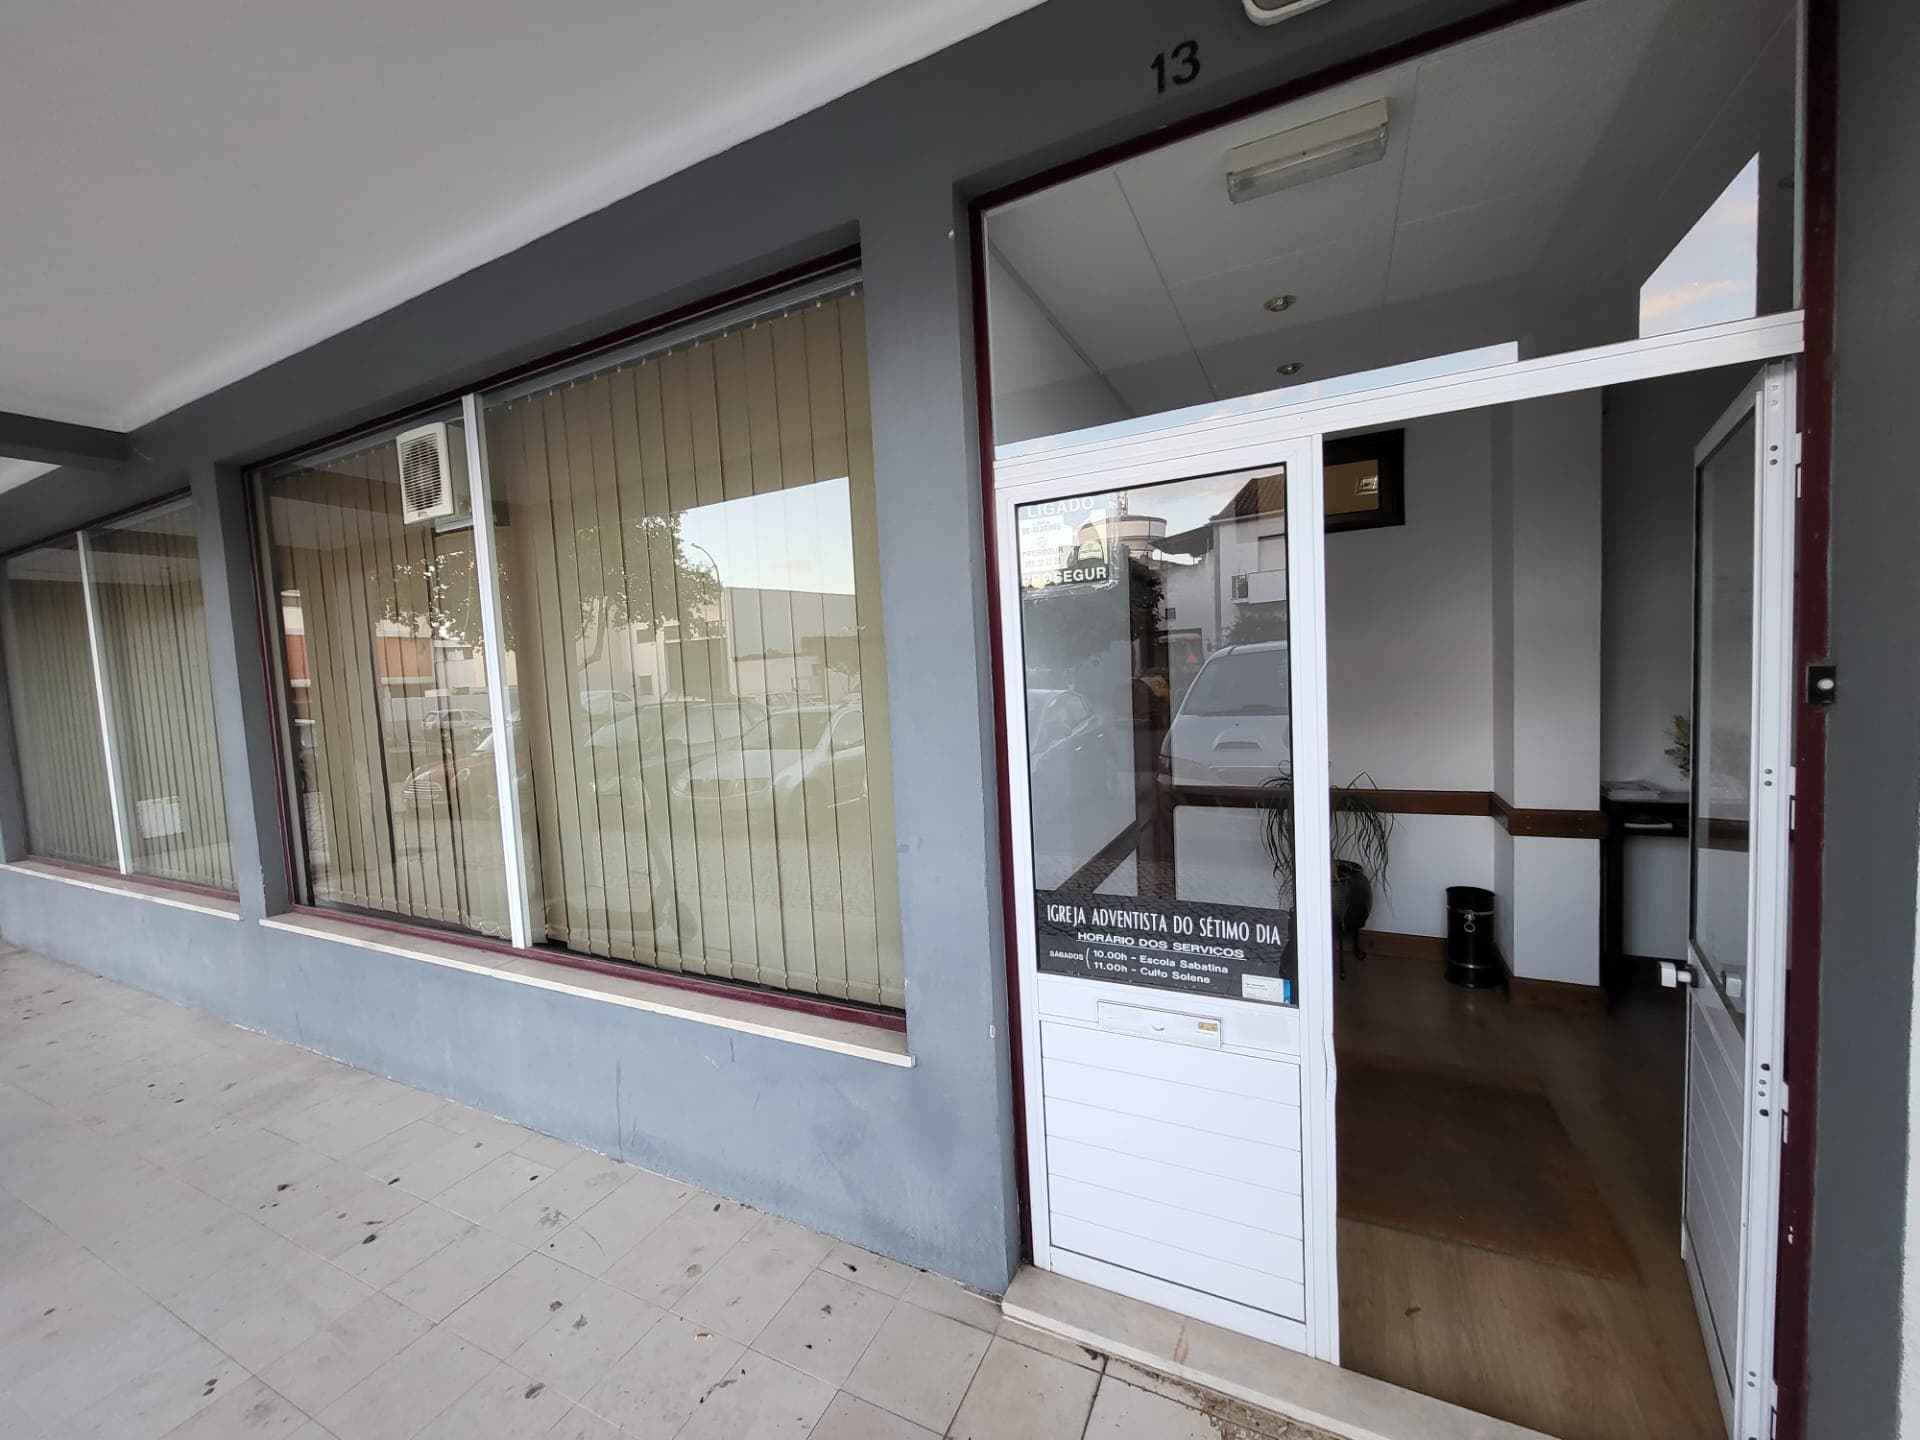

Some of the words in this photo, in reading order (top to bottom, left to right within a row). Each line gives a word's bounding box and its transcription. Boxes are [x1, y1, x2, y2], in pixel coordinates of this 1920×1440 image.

[1150, 40, 1200, 93] 13
[1027, 496, 1094, 518] LIGADO
[1047, 904, 1086, 927] IGREJA
[1091, 908, 1168, 933] ADVENTISTA
[1173, 915, 1193, 935] DO
[1199, 916, 1250, 942] SÉTIMO
[1256, 923, 1281, 946] DIA
[1077, 931, 1135, 946] HORÁRIO
[1138, 938, 1168, 950] DOS
[1172, 942, 1245, 958] SERVIÇOS
[1092, 949, 1128, 961] 10.00h
[1139, 954, 1176, 967] Escola
[1179, 959, 1229, 974] Sabatina
[1092, 961, 1128, 973] 11.00h
[1139, 966, 1169, 978] Culto
[1171, 970, 1212, 984] Solene
